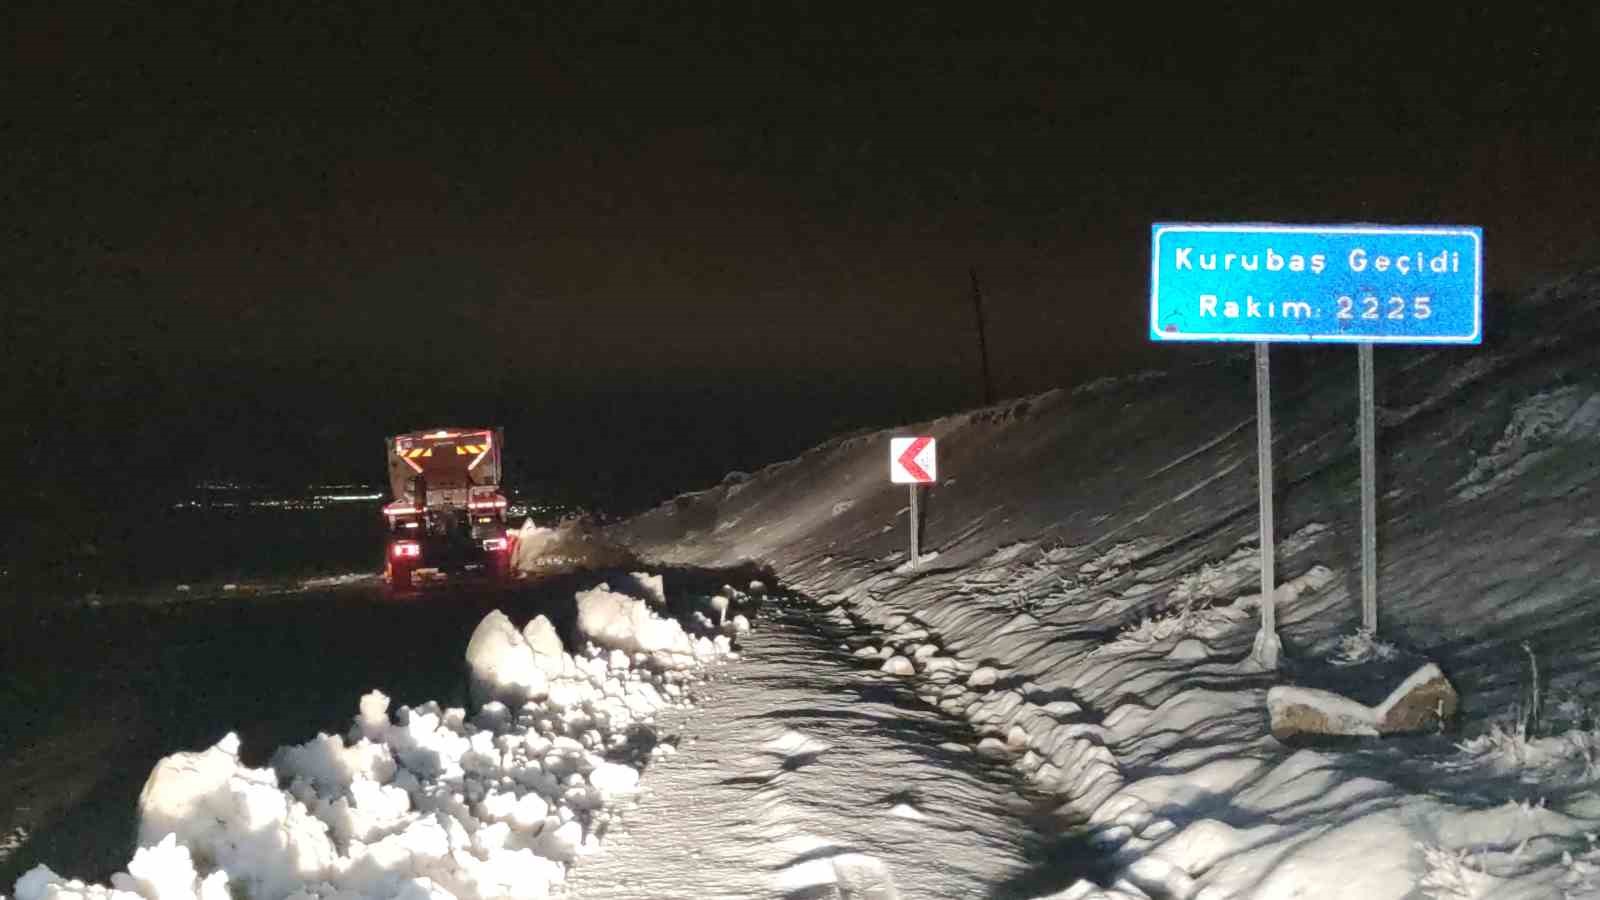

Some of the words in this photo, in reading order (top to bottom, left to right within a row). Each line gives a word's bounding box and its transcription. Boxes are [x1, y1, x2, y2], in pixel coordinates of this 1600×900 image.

[1175, 247, 1326, 274] Kurubaş
[1349, 248, 1460, 275] Geçidi
[1336, 296, 1432, 320] 2225
